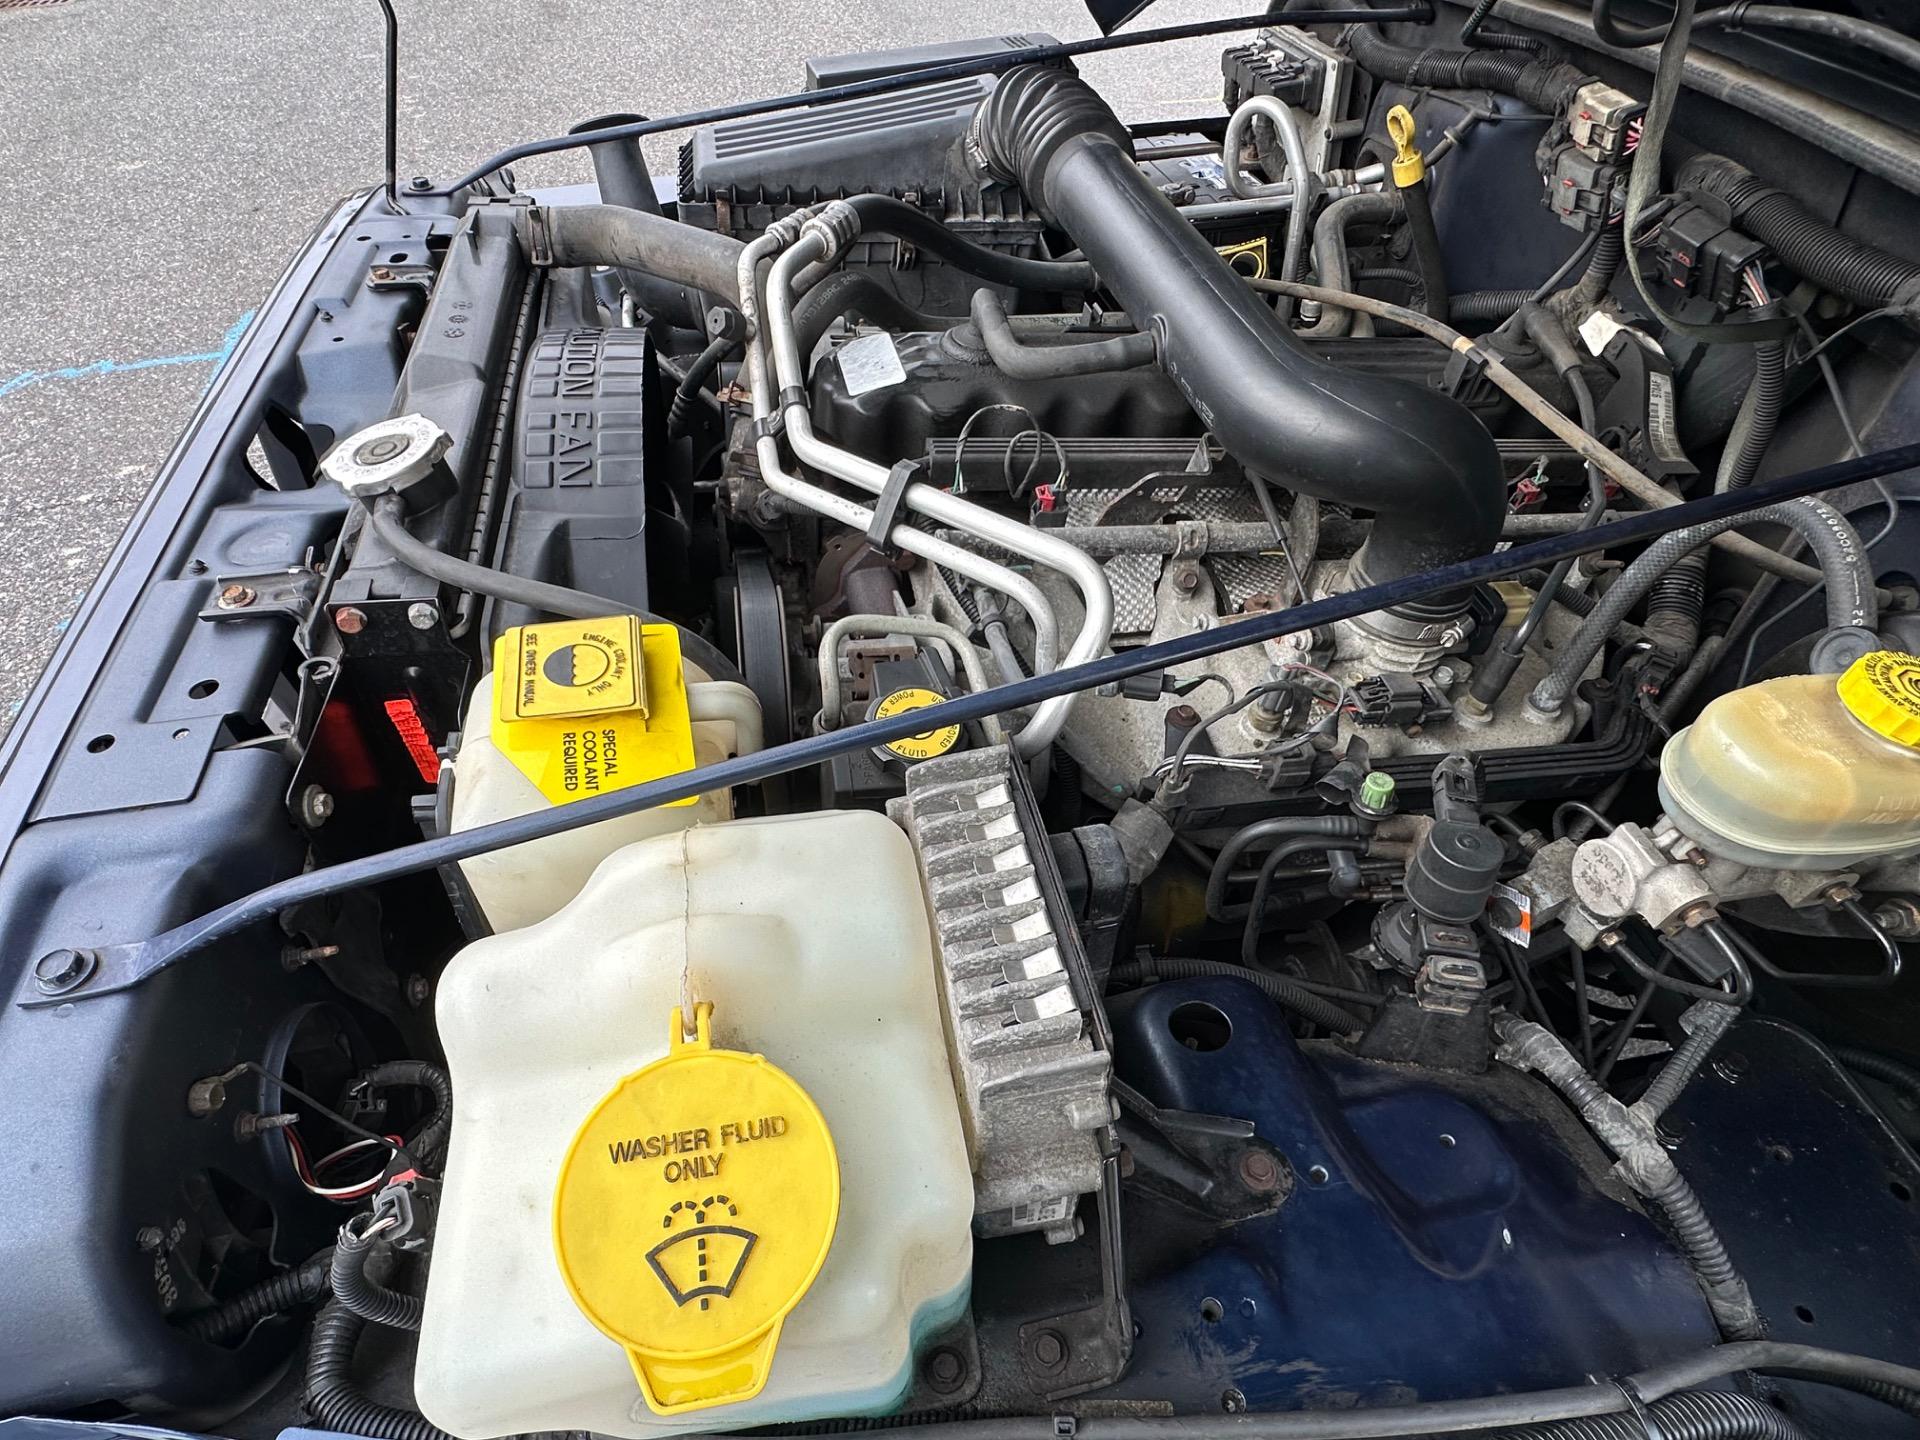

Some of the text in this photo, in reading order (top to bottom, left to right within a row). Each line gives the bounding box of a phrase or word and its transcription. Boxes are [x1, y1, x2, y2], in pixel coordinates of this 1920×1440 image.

[559, 328, 604, 488] AUTION FAN
[526, 633, 538, 647] SEE
[582, 632, 627, 697] ENGINE COOLANT ONLY
[523, 679, 536, 707] MANUAL
[889, 690, 915, 705] POWER
[562, 732, 579, 792] REQUIRED
[583, 730, 599, 791] COOLANT
[602, 728, 618, 777] SPECIAL
[896, 744, 928, 757] FLUID
[608, 1115, 786, 1165] WASHER FLUID
[664, 1152, 724, 1183] ONLY
